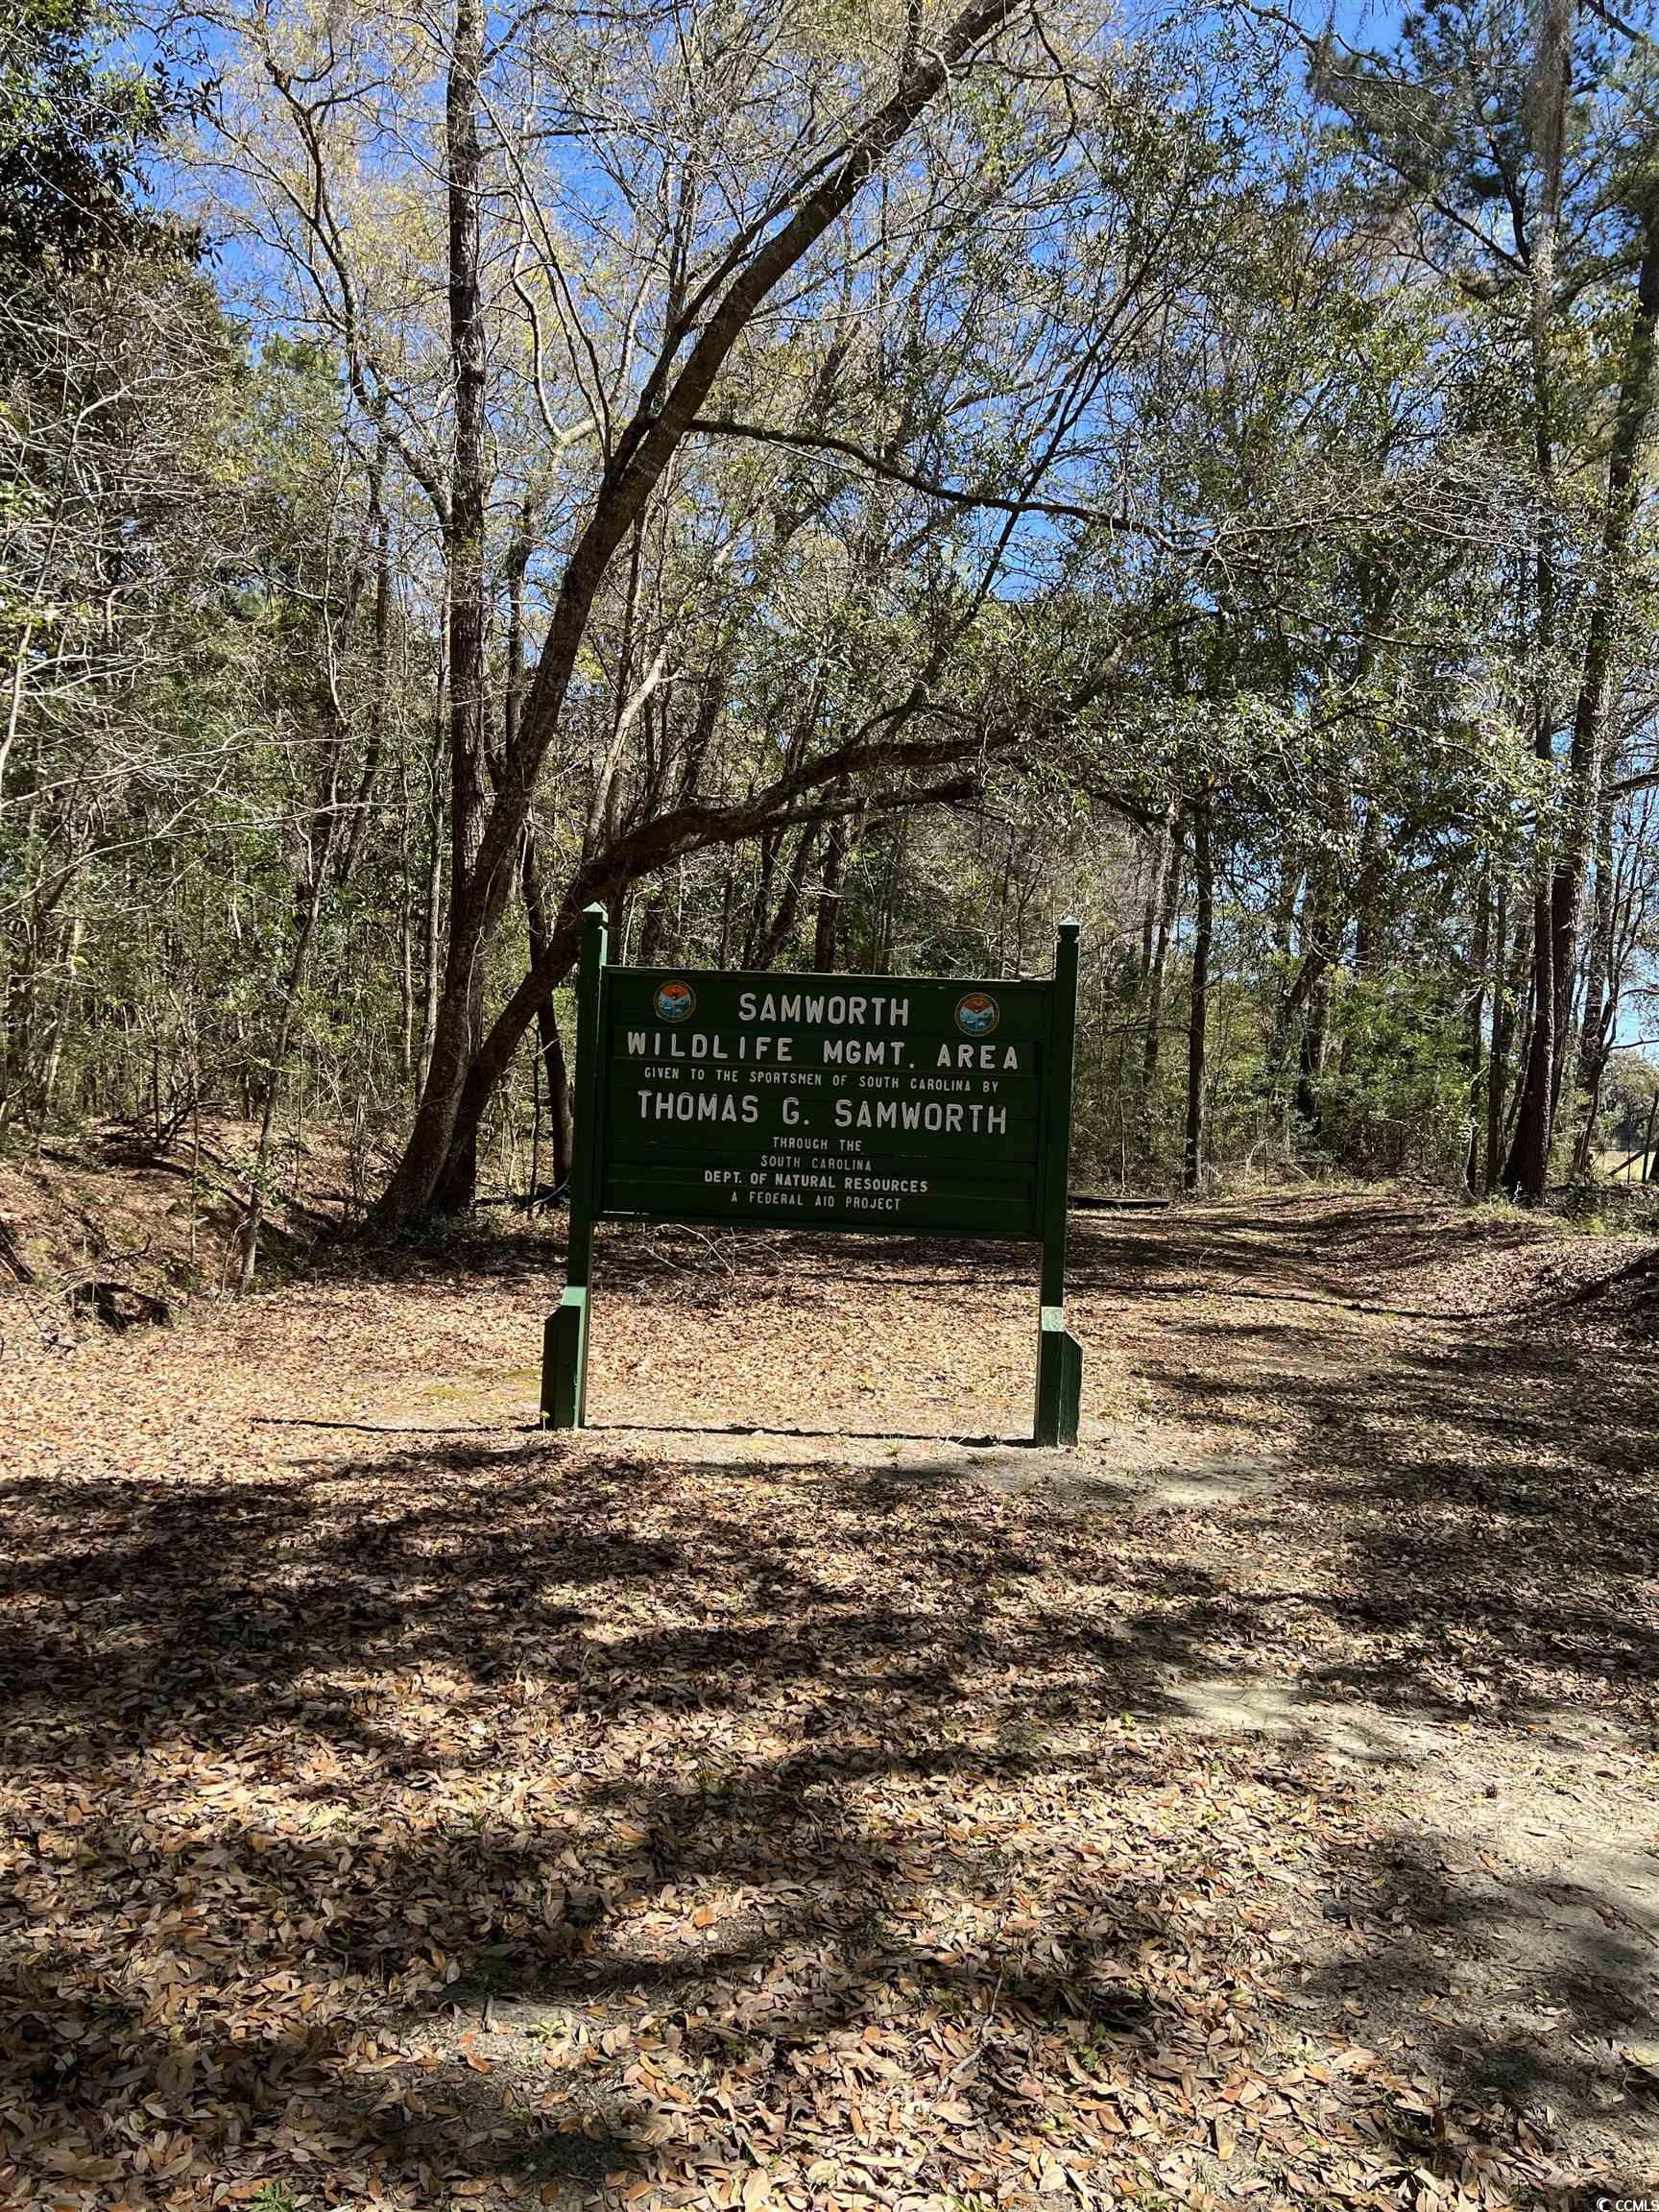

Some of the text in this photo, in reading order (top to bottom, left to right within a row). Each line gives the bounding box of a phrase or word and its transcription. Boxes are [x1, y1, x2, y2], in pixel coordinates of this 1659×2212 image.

[738, 992, 909, 1026] SAMWORTH
[627, 1031, 1019, 1070] WILDLIFE MGMT. AREA
[644, 1067, 998, 1093] GIVEN TO THE SPORTSMEN OF SOUTH CAROLINA BY
[637, 1090, 1006, 1135] THOMAS G. SAMWORTH
[773, 1136, 862, 1152] THROUGH THE
[760, 1154, 872, 1171] SOUTH CAROLINA
[704, 1169, 928, 1193] DEPT. OF NATURAL RESOURCES
[730, 1190, 902, 1211] A FEDERAL AID PROJECT
